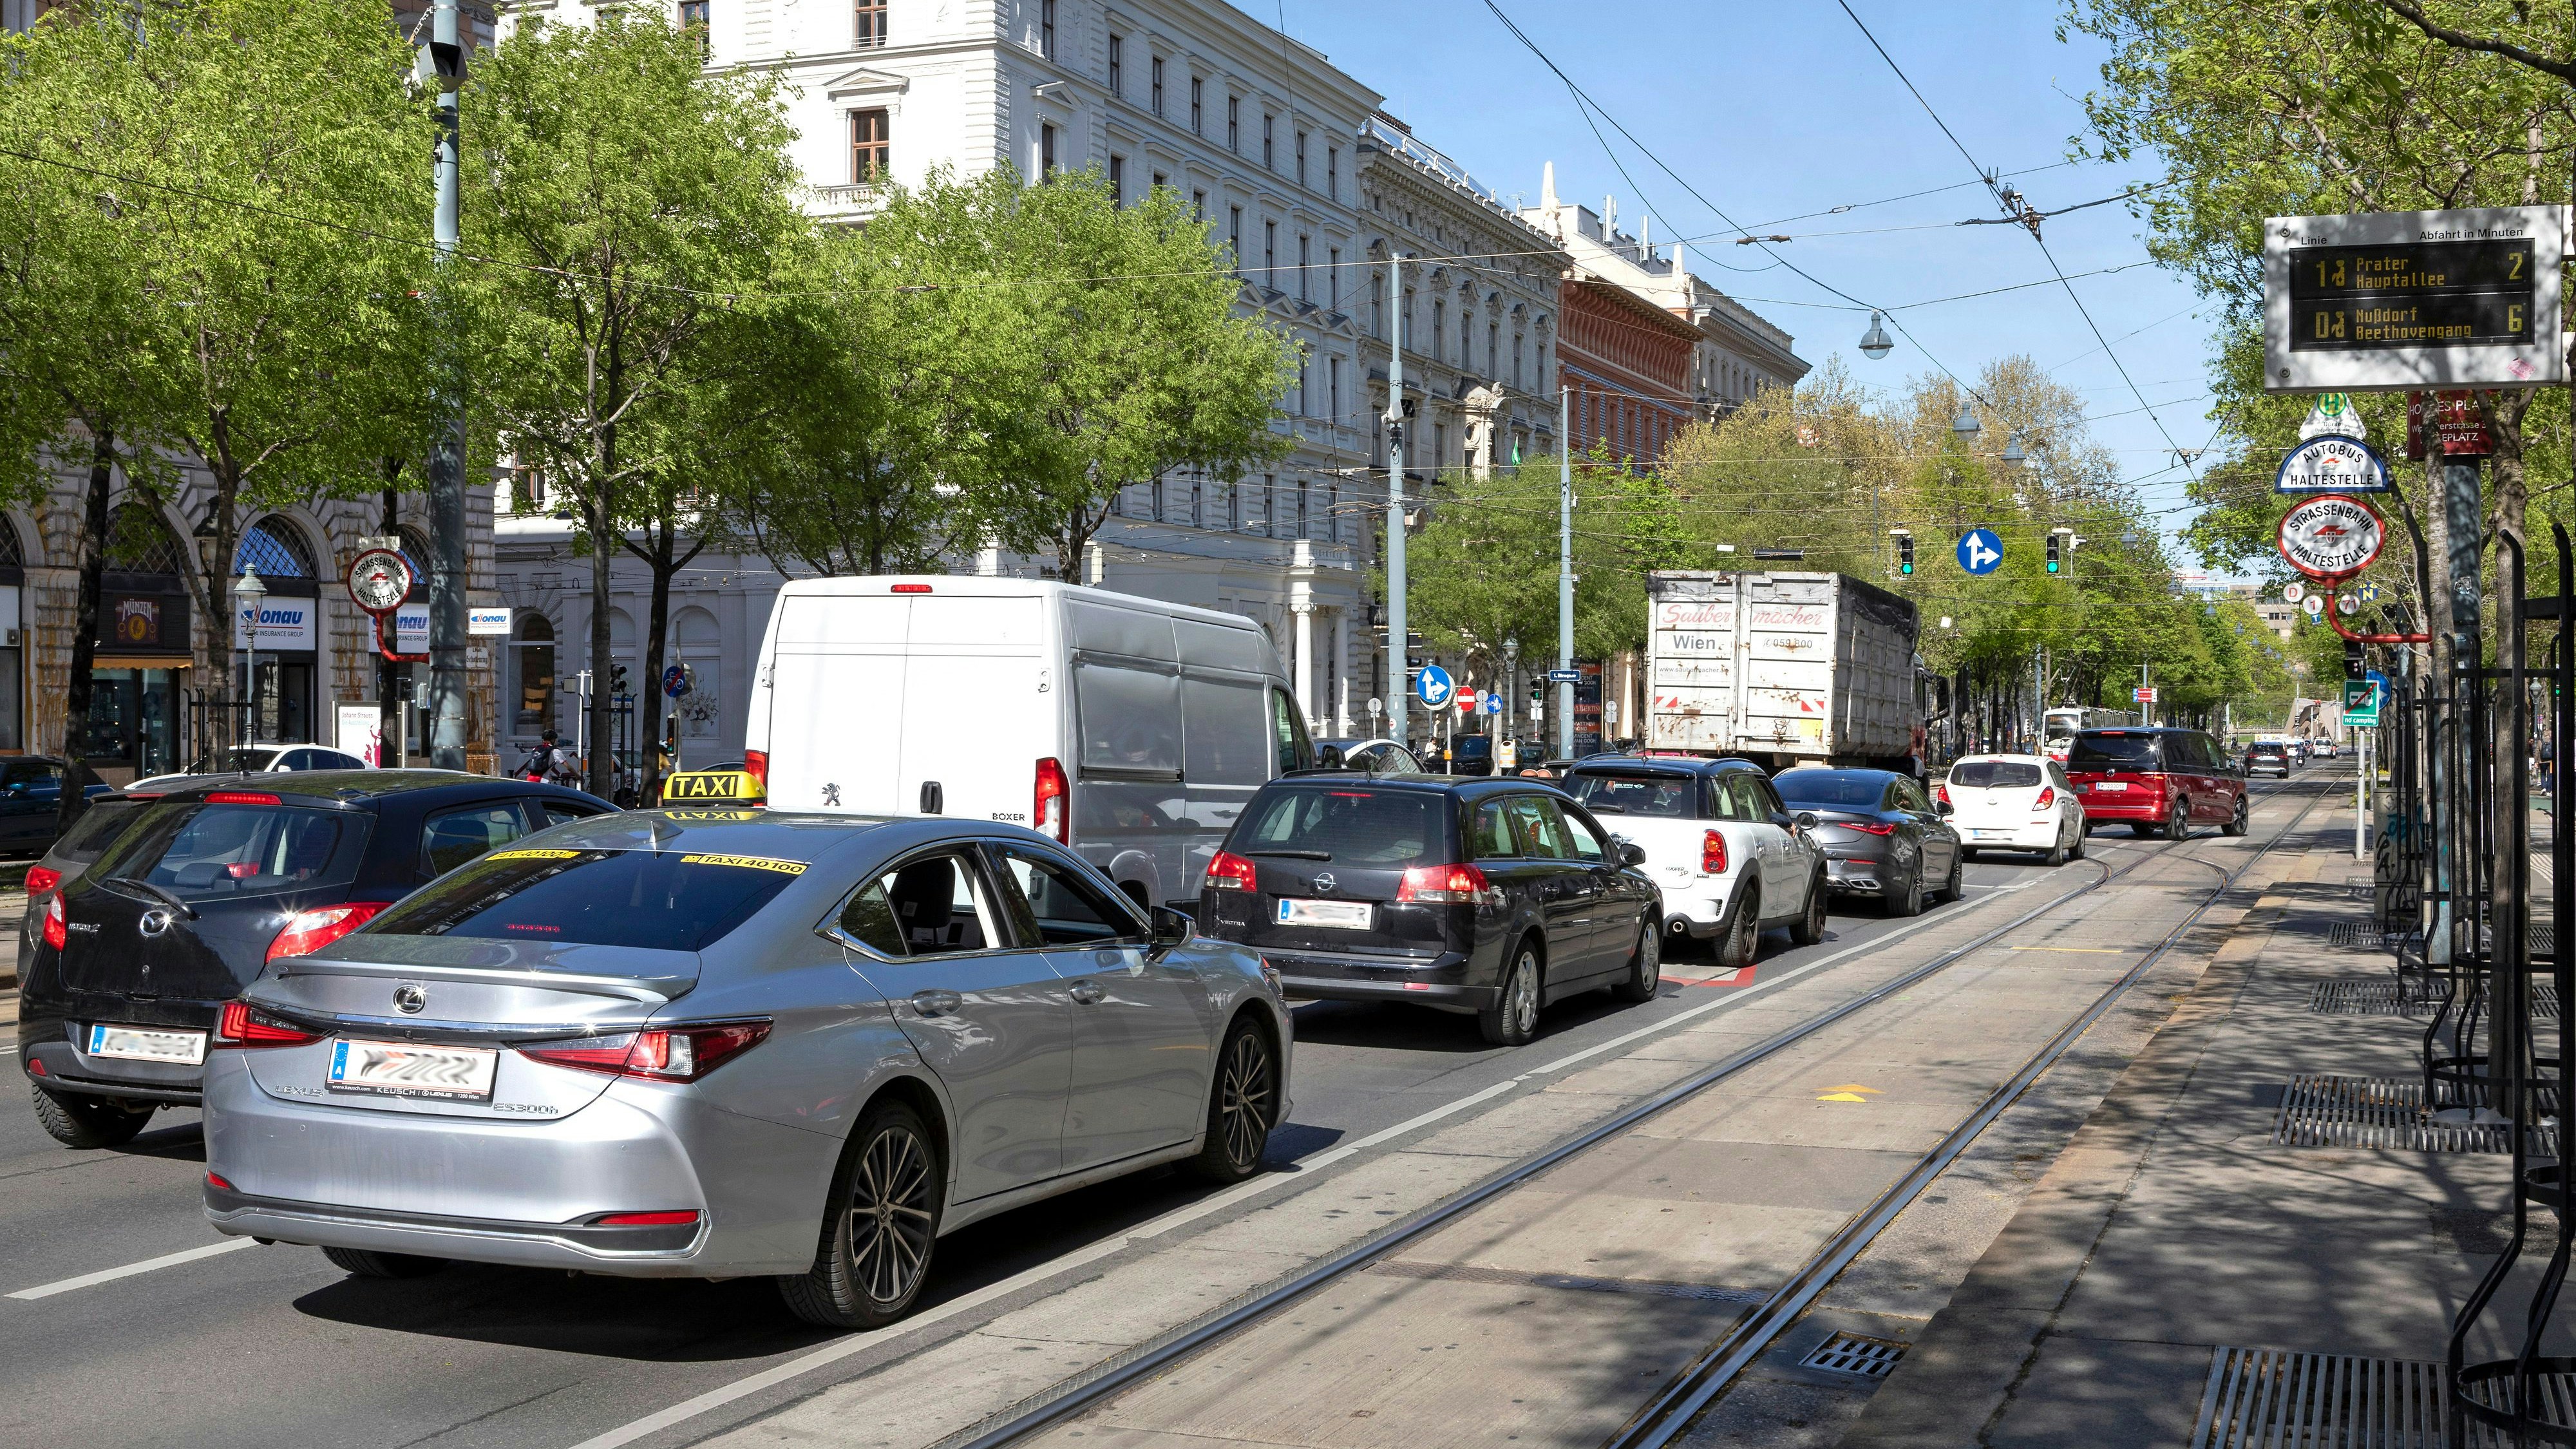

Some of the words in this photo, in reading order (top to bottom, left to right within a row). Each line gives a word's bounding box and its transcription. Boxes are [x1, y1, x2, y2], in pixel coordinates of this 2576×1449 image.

[2301, 236, 2327, 245] Linie
[2420, 229, 2460, 241] Abfahrt
[2464, 229, 2474, 239] in
[2477, 227, 2524, 238] Minuten
[2356, 256, 2409, 272] Prater
[2508, 252, 2523, 280] 2
[2316, 261, 2326, 287] 1
[2356, 272, 2445, 290] Hauptallee
[2356, 307, 2418, 323] Nußdorf
[2508, 305, 2523, 332] 6
[2356, 324, 2472, 341] Beethovengang
[2303, 444, 2364, 464] AUTOBUS
[2290, 473, 2373, 486] HALTESTELLE
[2289, 504, 2374, 533] STRASSENBAHN
[2292, 544, 2370, 567] HALTESTELLE
[355, 557, 404, 578] STRASSENBAHN
[357, 587, 402, 605] HALTESTELLE
[2289, 587, 2298, 598] D
[122, 598, 153, 623] MÜNZEN
[2310, 600, 2316, 610] 1
[2342, 599, 2356, 610] 71
[471, 614, 507, 622] donau
[1663, 604, 1731, 623] Sauber
[1752, 605, 1823, 626] macher
[1673, 634, 1716, 650] Wien
[2353, 717, 2376, 725] camping
[676, 775, 737, 797] TAXI
[992, 813, 1025, 821] BOXER
[705, 857, 743, 865] TAXI
[335, 1066, 342, 1075] A
[275, 1084, 324, 1097] LEXUS
[377, 1087, 415, 1095] KEUSCH
